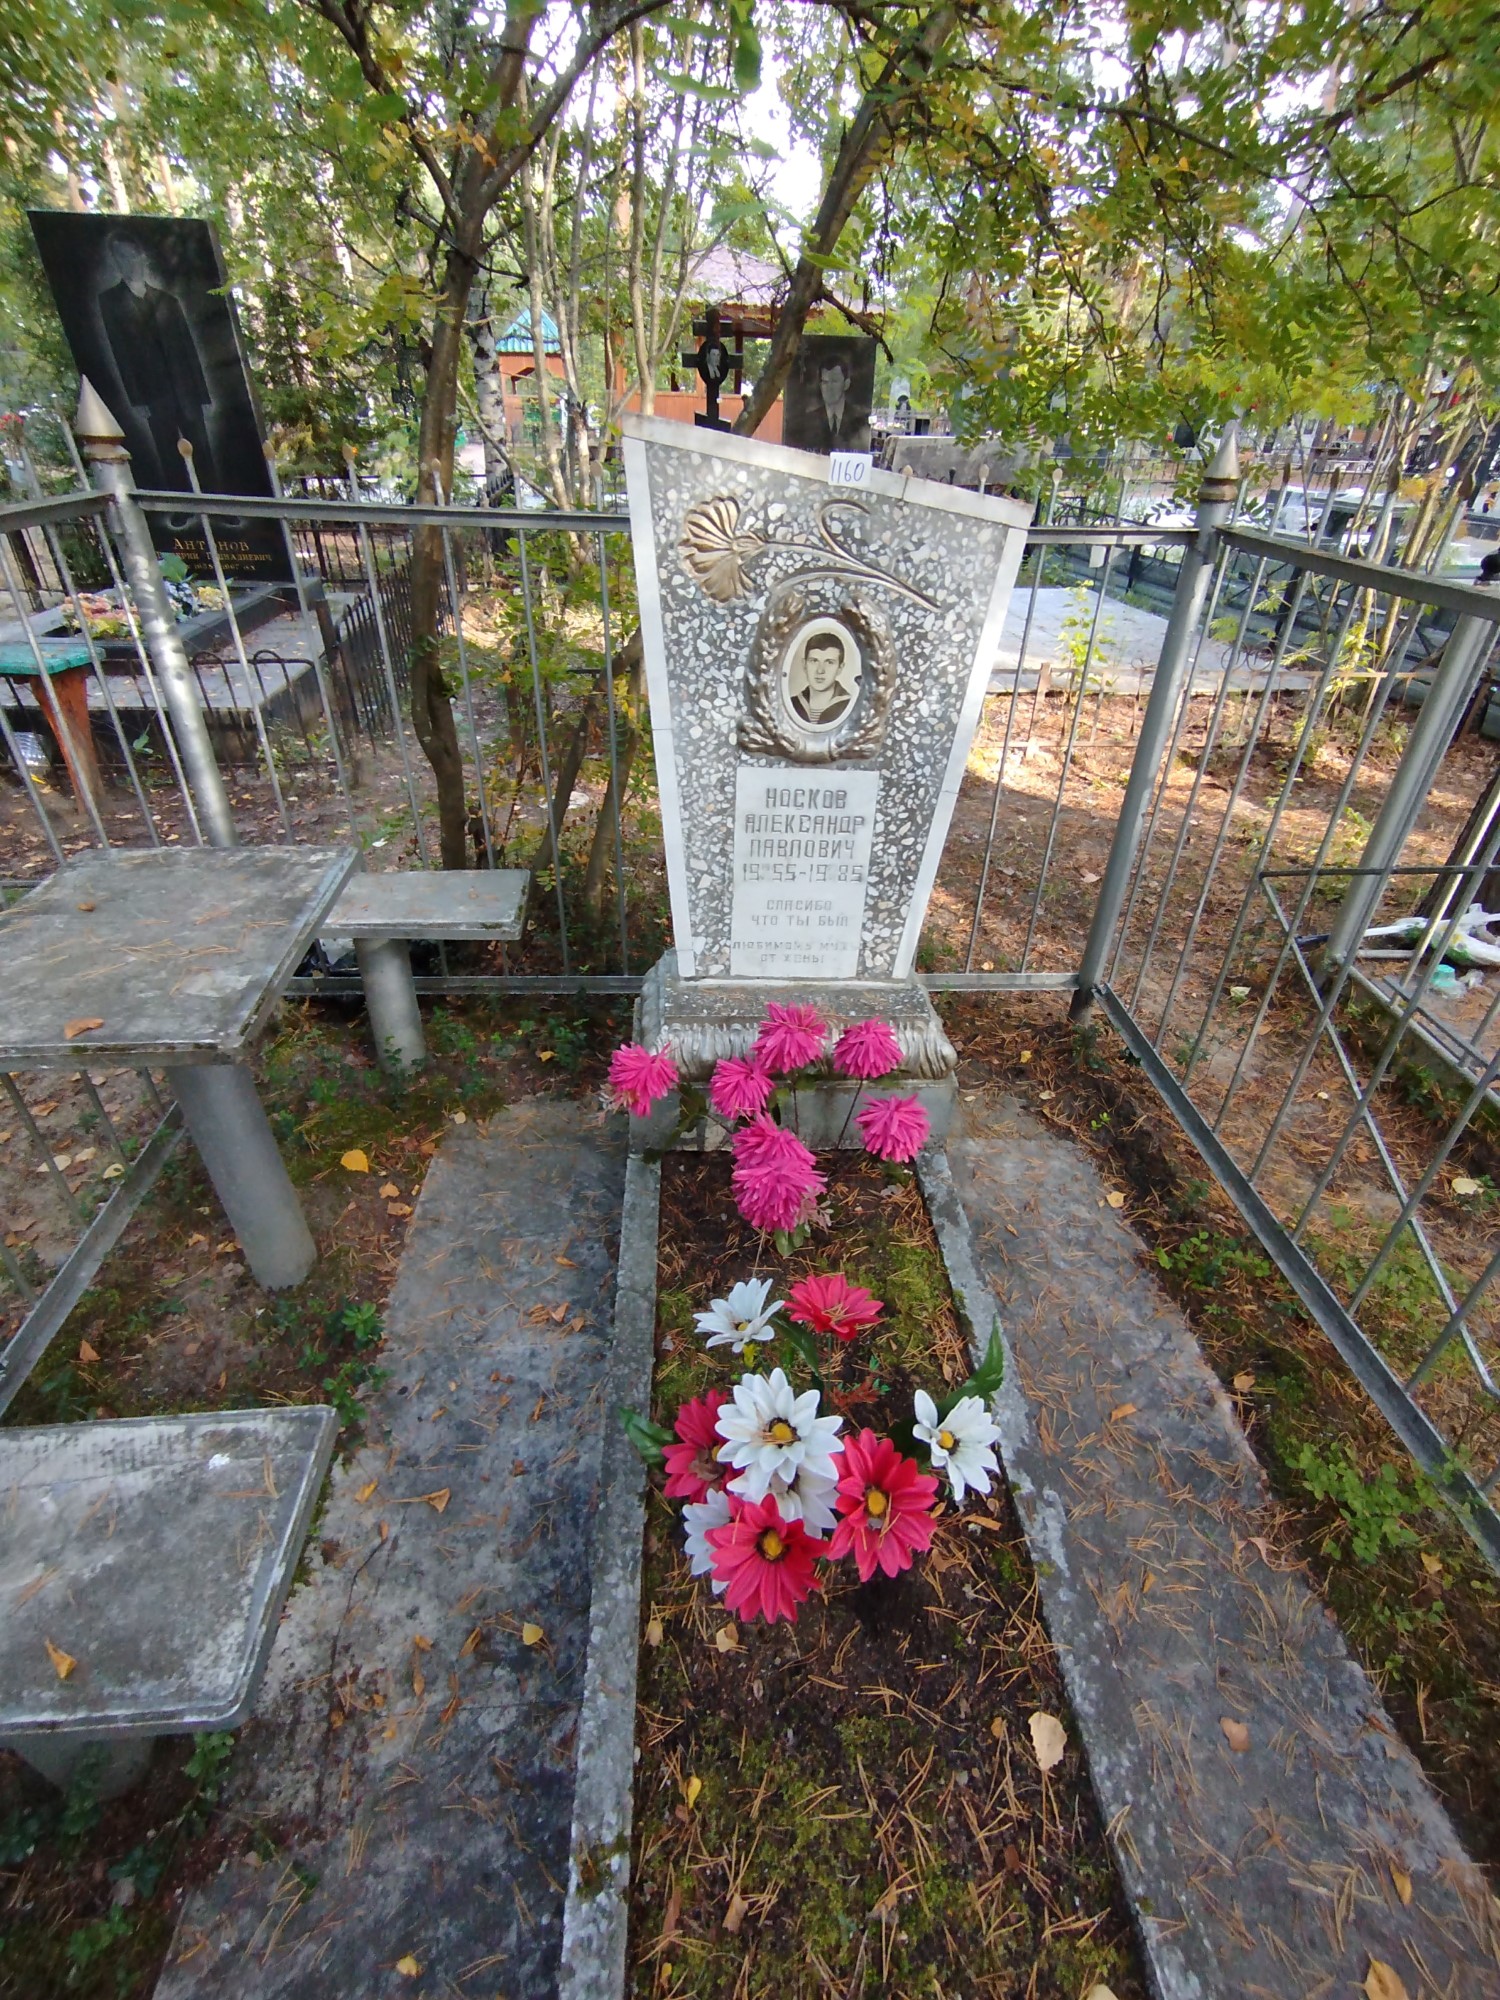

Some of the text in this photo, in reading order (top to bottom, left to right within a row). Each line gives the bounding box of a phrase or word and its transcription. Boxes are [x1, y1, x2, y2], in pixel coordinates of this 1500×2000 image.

[831, 459, 864, 484] 1160
[173, 538, 250, 551] АНТНОВ
[766, 788, 847, 809] НОСКОВ
[745, 814, 865, 834] АЛЕКСАНДР
[750, 839, 855, 859] ПАВЛОВИЧ
[766, 899, 832, 911] СПАСИБО
[751, 915, 848, 926] ЧТО ТЫ БЫЛ
[761, 954, 824, 963] ОТ ЖЕНЫ
